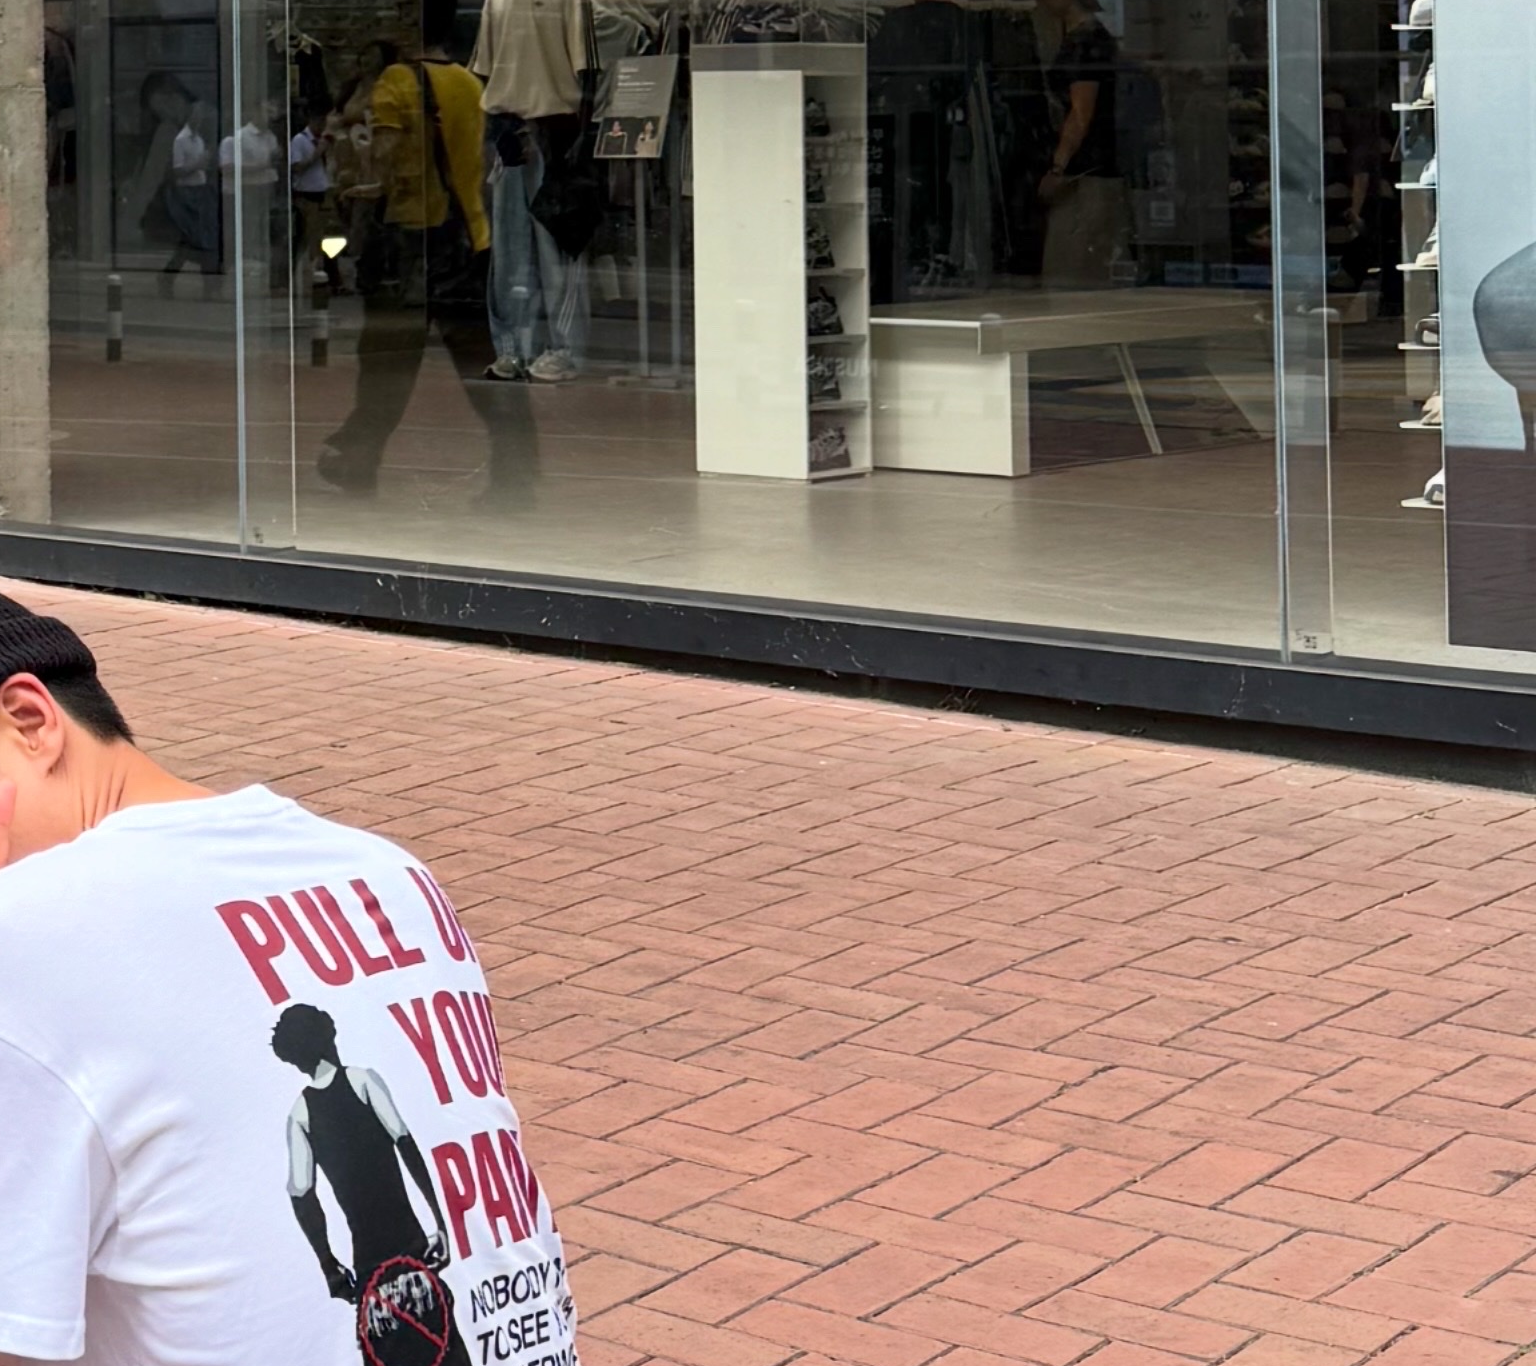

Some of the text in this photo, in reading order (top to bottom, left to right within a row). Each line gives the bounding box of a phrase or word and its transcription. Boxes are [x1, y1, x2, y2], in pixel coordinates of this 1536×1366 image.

[214, 866, 477, 1005] PULL U
[387, 990, 506, 1104] YOU
[431, 1128, 559, 1260] PAN
[470, 1260, 551, 1324] NOBODY
[507, 1308, 551, 1354] SEE
